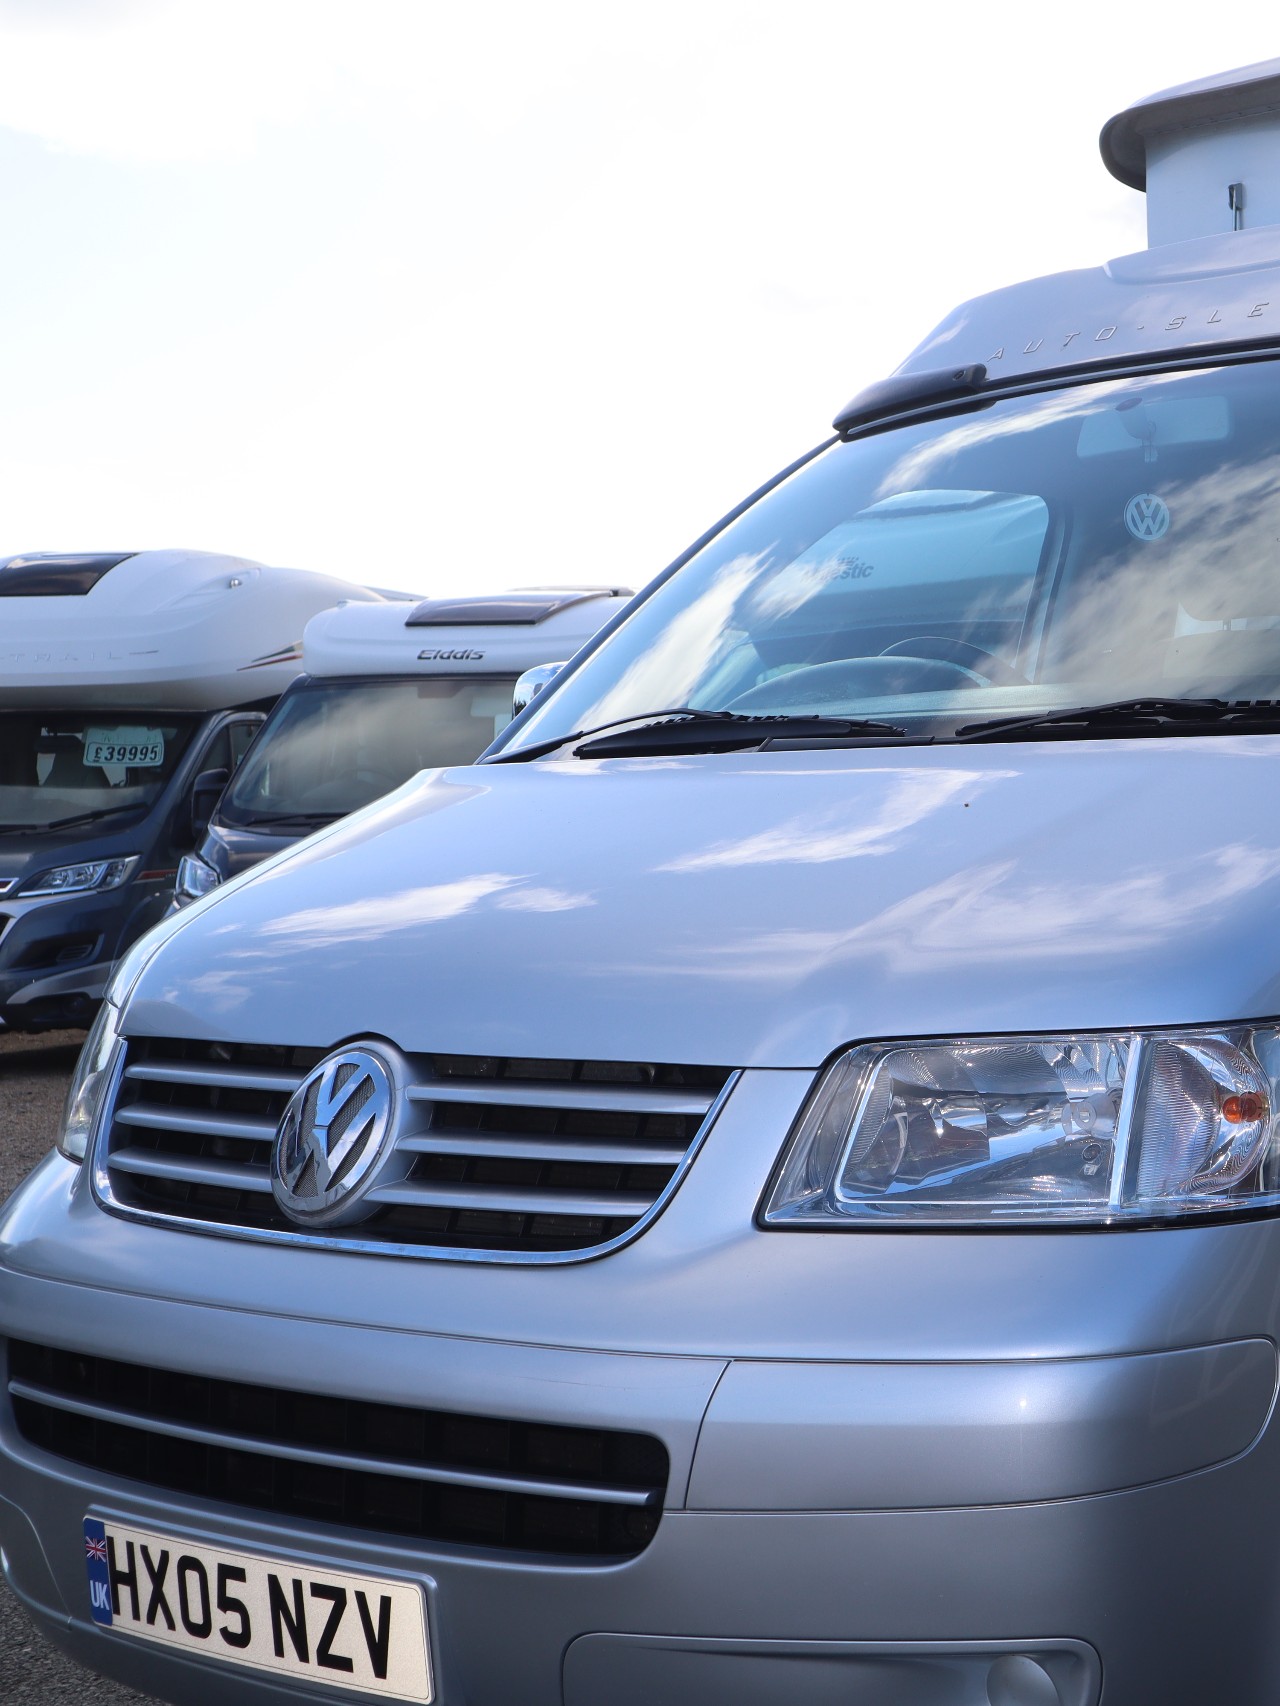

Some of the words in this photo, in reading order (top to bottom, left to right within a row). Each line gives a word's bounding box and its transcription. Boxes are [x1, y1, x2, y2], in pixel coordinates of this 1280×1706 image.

[416, 648, 486, 661] Elddis
[94, 744, 159, 762] £39995
[90, 1580, 110, 1611] UK
[106, 1535, 252, 1649] HX05
[267, 1573, 392, 1680] NZV
